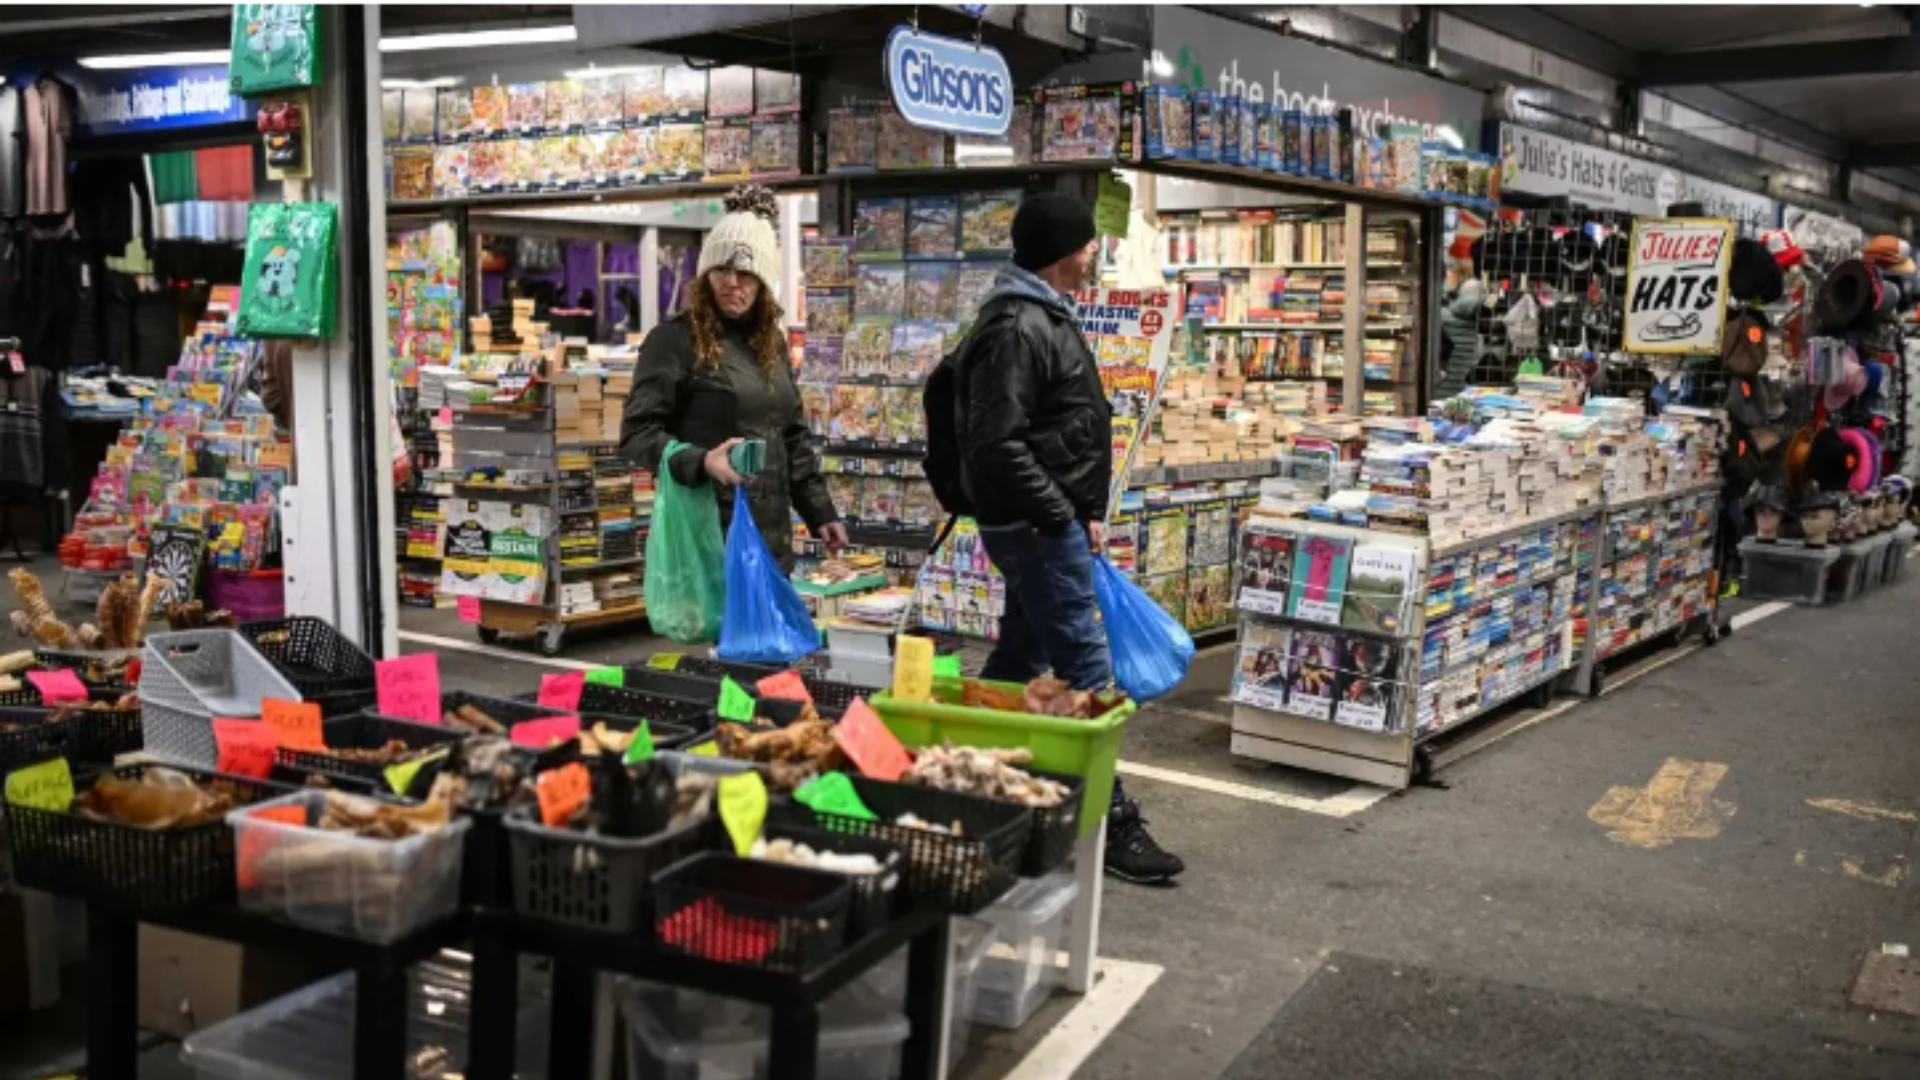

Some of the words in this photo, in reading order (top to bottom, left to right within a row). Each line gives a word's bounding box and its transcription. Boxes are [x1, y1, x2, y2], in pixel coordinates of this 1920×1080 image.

[901, 48, 1004, 116] Gibsons
[1218, 60, 1264, 103] the
[1518, 135, 1568, 181] Julie's
[1571, 149, 1605, 189] Hats
[1608, 158, 1617, 191] 4
[1618, 161, 1656, 200] Gents
[1643, 231, 1720, 261] JULIE'S
[1630, 274, 1719, 314] HATS
